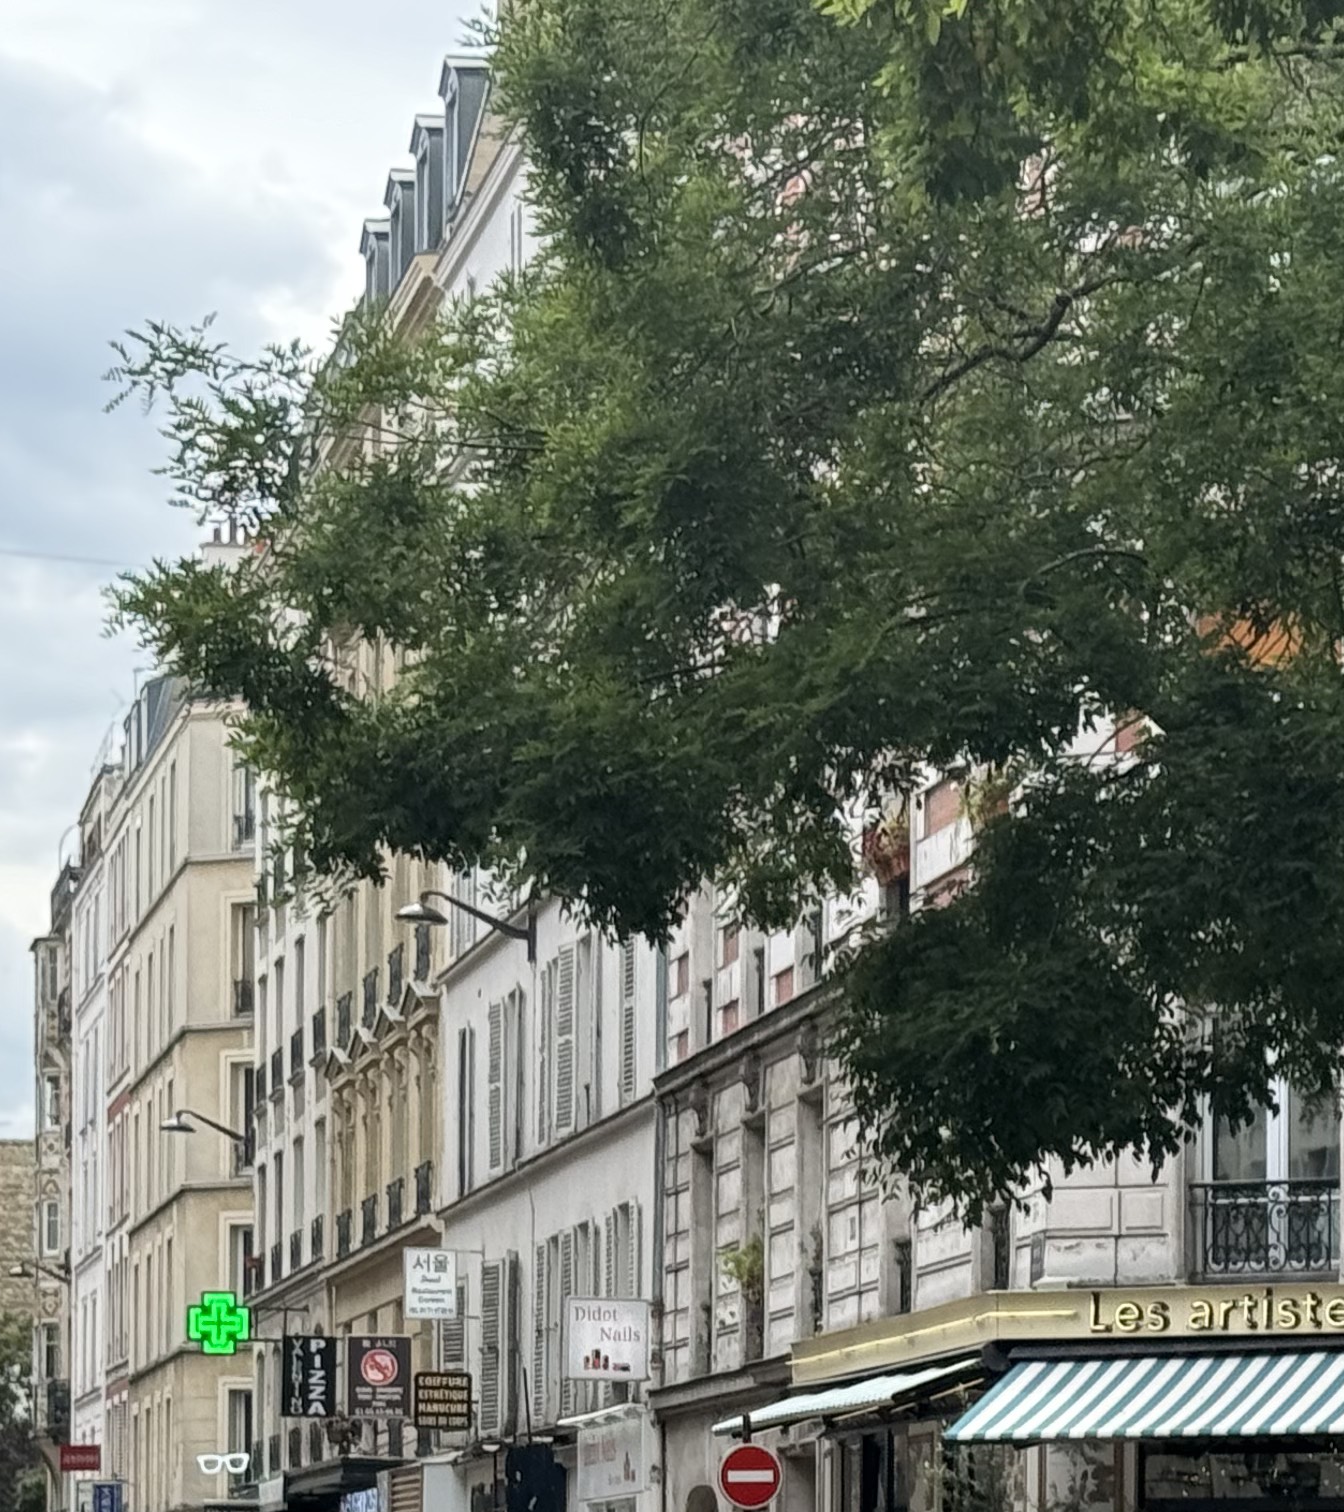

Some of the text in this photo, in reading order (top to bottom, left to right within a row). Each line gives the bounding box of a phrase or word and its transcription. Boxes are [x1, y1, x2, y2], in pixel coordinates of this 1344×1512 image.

[412, 1253, 450, 1273] 서울
[574, 1306, 618, 1322] Didot
[1089, 1291, 1172, 1333] Les
[599, 1327, 642, 1343] Nails
[307, 1338, 327, 1416] PIZZA
[418, 1375, 469, 1387] COIFFURE
[418, 1402, 469, 1414] MANUCURE
